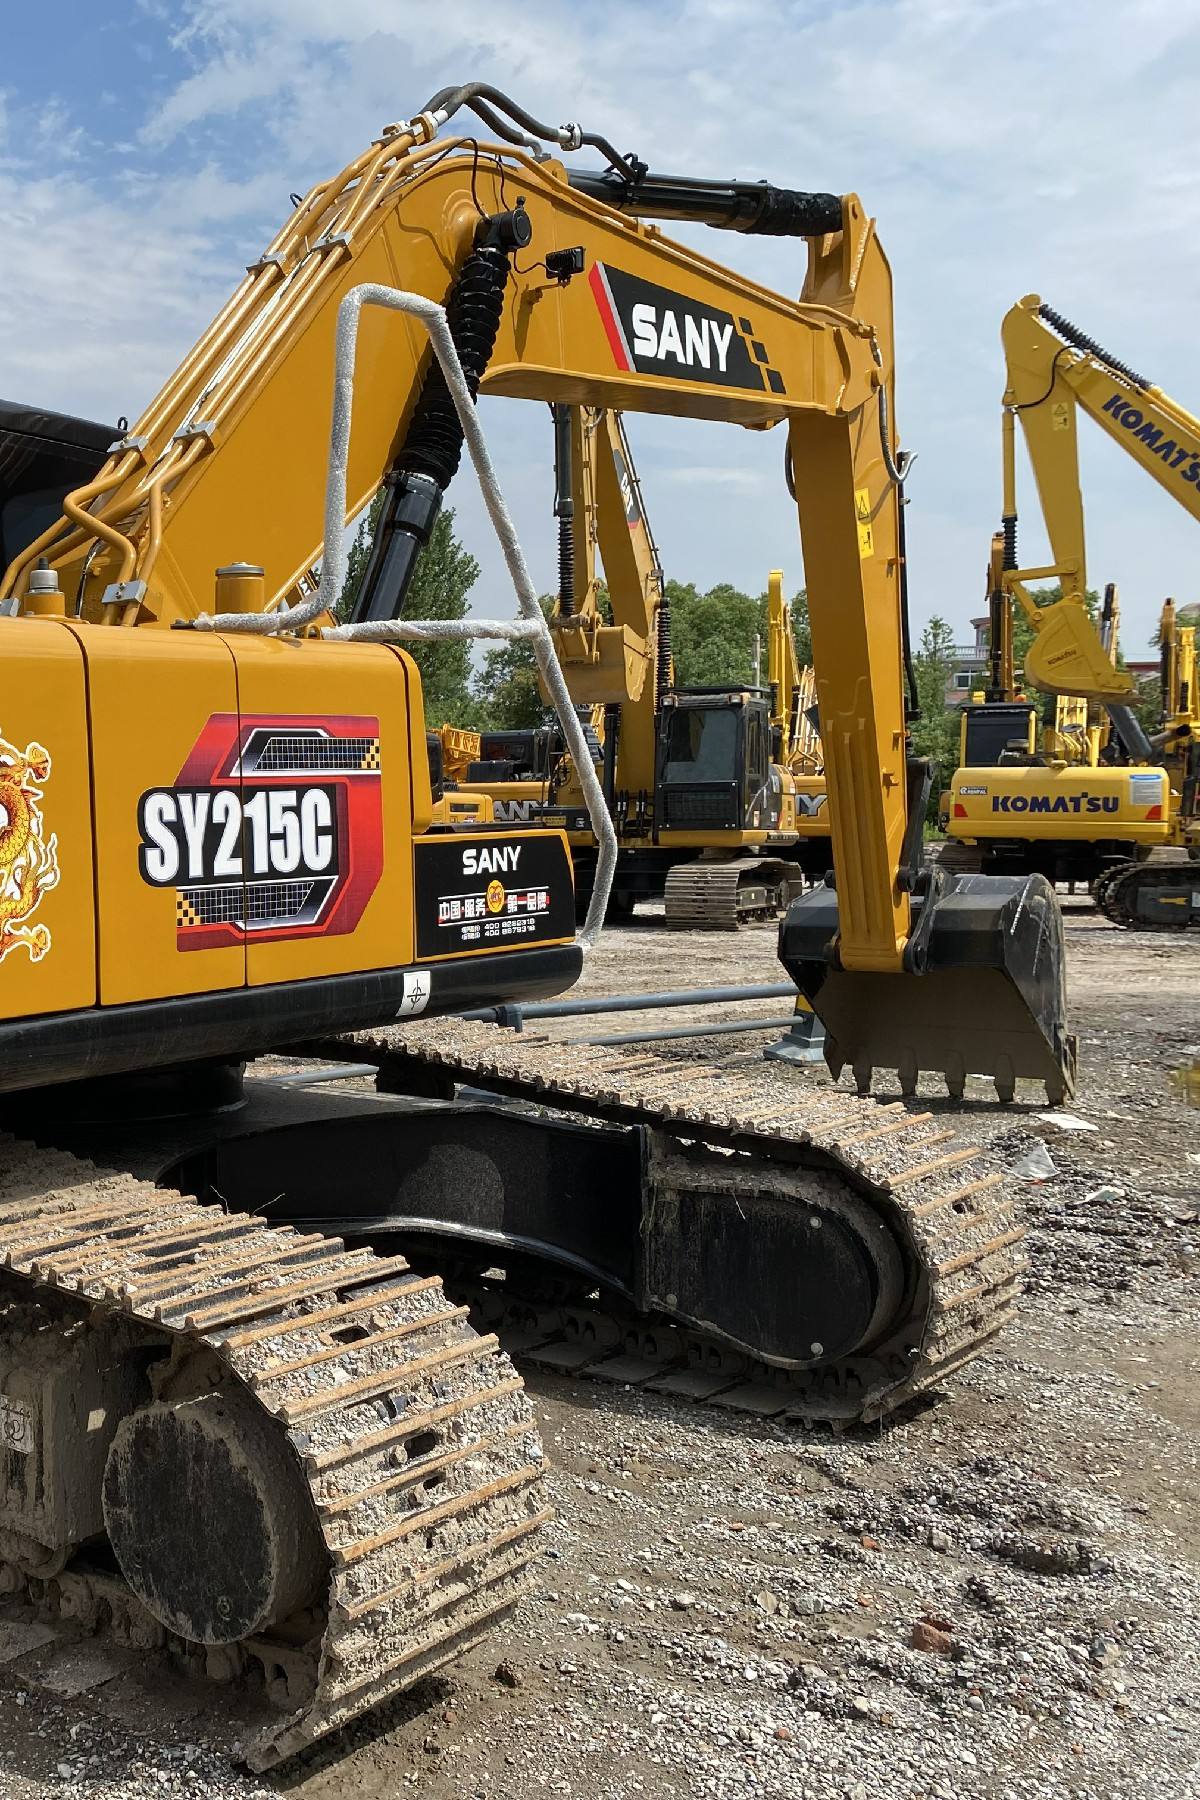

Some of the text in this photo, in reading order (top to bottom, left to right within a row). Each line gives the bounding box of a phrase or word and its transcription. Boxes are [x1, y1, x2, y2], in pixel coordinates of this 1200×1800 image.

[632, 303, 733, 372] SANY
[1102, 393, 1200, 494] KOMATS
[143, 788, 333, 882] SY215C
[992, 792, 1120, 813] KOMATSU
[462, 846, 521, 874] SANY
